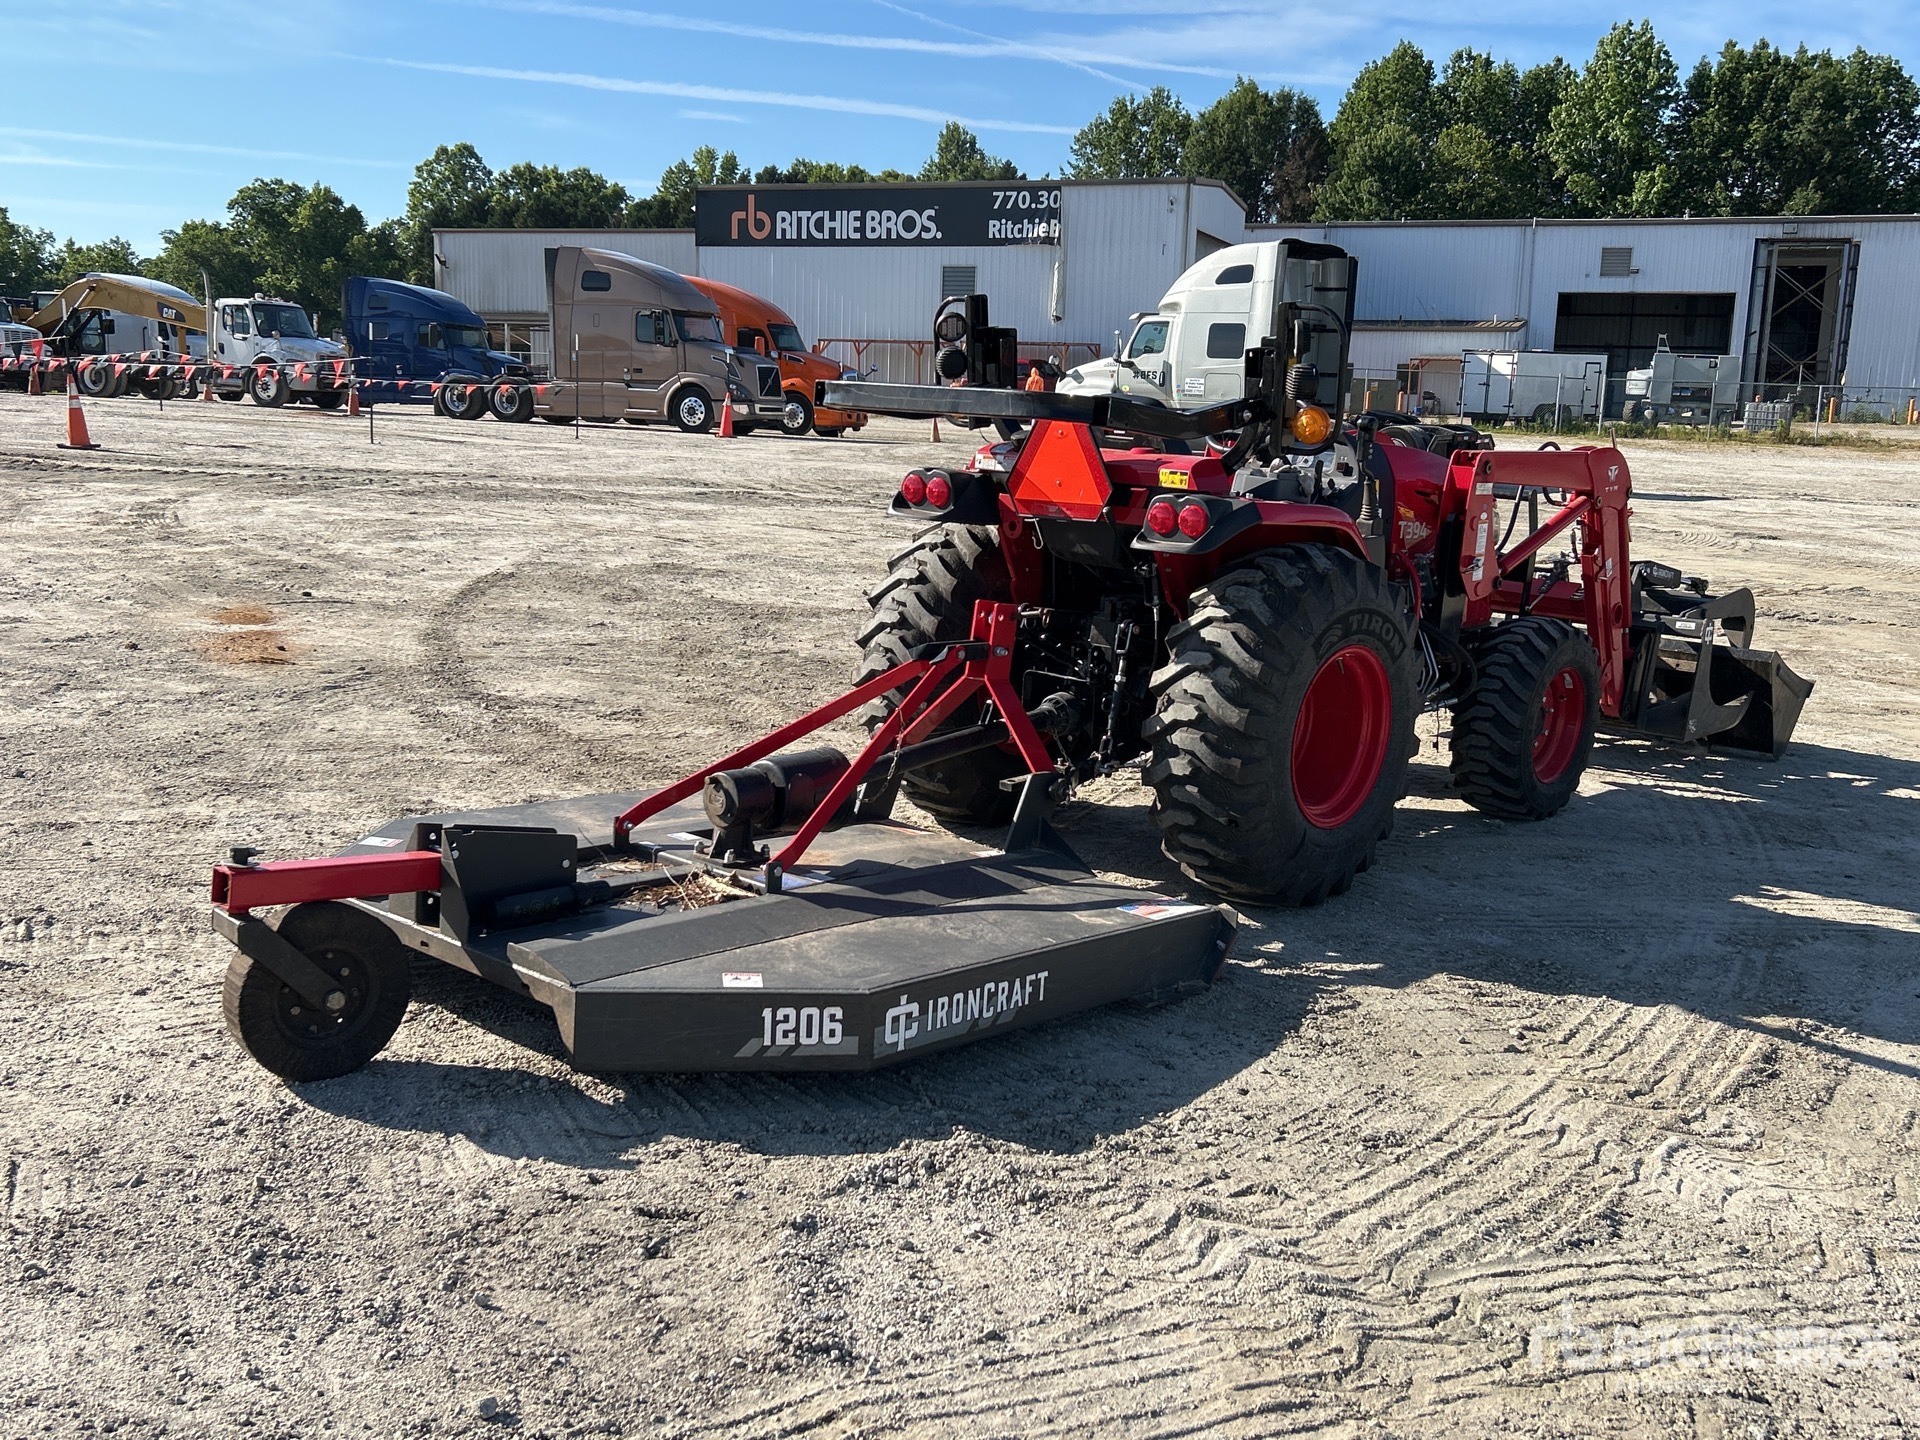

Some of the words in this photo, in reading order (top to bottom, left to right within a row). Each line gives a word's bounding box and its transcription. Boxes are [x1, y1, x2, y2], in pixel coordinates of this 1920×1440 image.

[776, 210, 861, 239] RITCHIE
[866, 209, 942, 239] BROS.
[163, 307, 176, 319] CAT
[1398, 520, 1427, 539] T394
[1349, 613, 1402, 659] TIRON
[927, 970, 1049, 1031] IRONCRAFT
[761, 1006, 844, 1046] 1206
